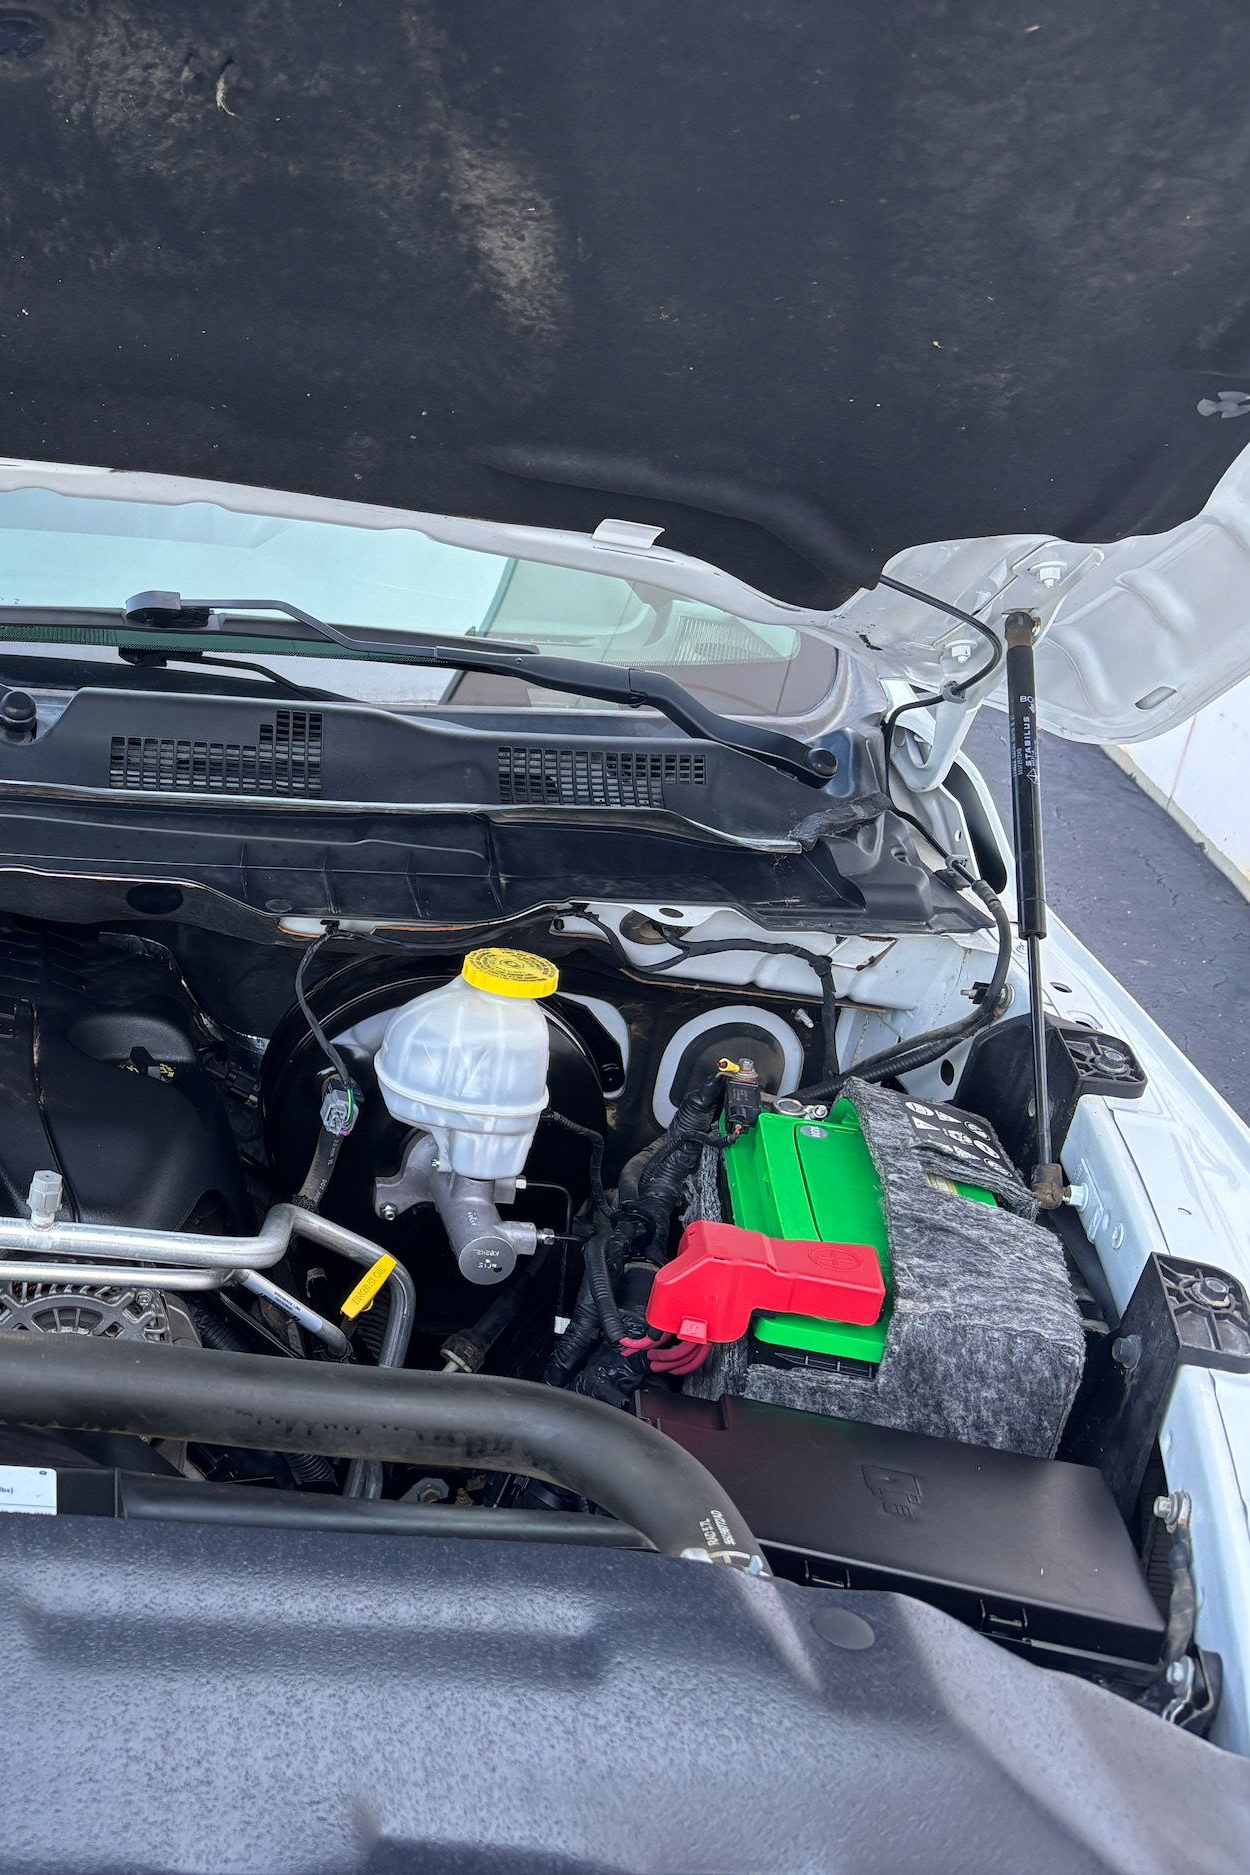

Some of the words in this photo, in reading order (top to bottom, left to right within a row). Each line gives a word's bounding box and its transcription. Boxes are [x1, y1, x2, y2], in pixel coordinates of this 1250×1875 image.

[1023, 716, 1032, 767] STABILUS
[351, 1278, 376, 1305] ENGINE
[373, 1265, 387, 1279] OIL
[0, 1486, 14, 1494] lbs)
